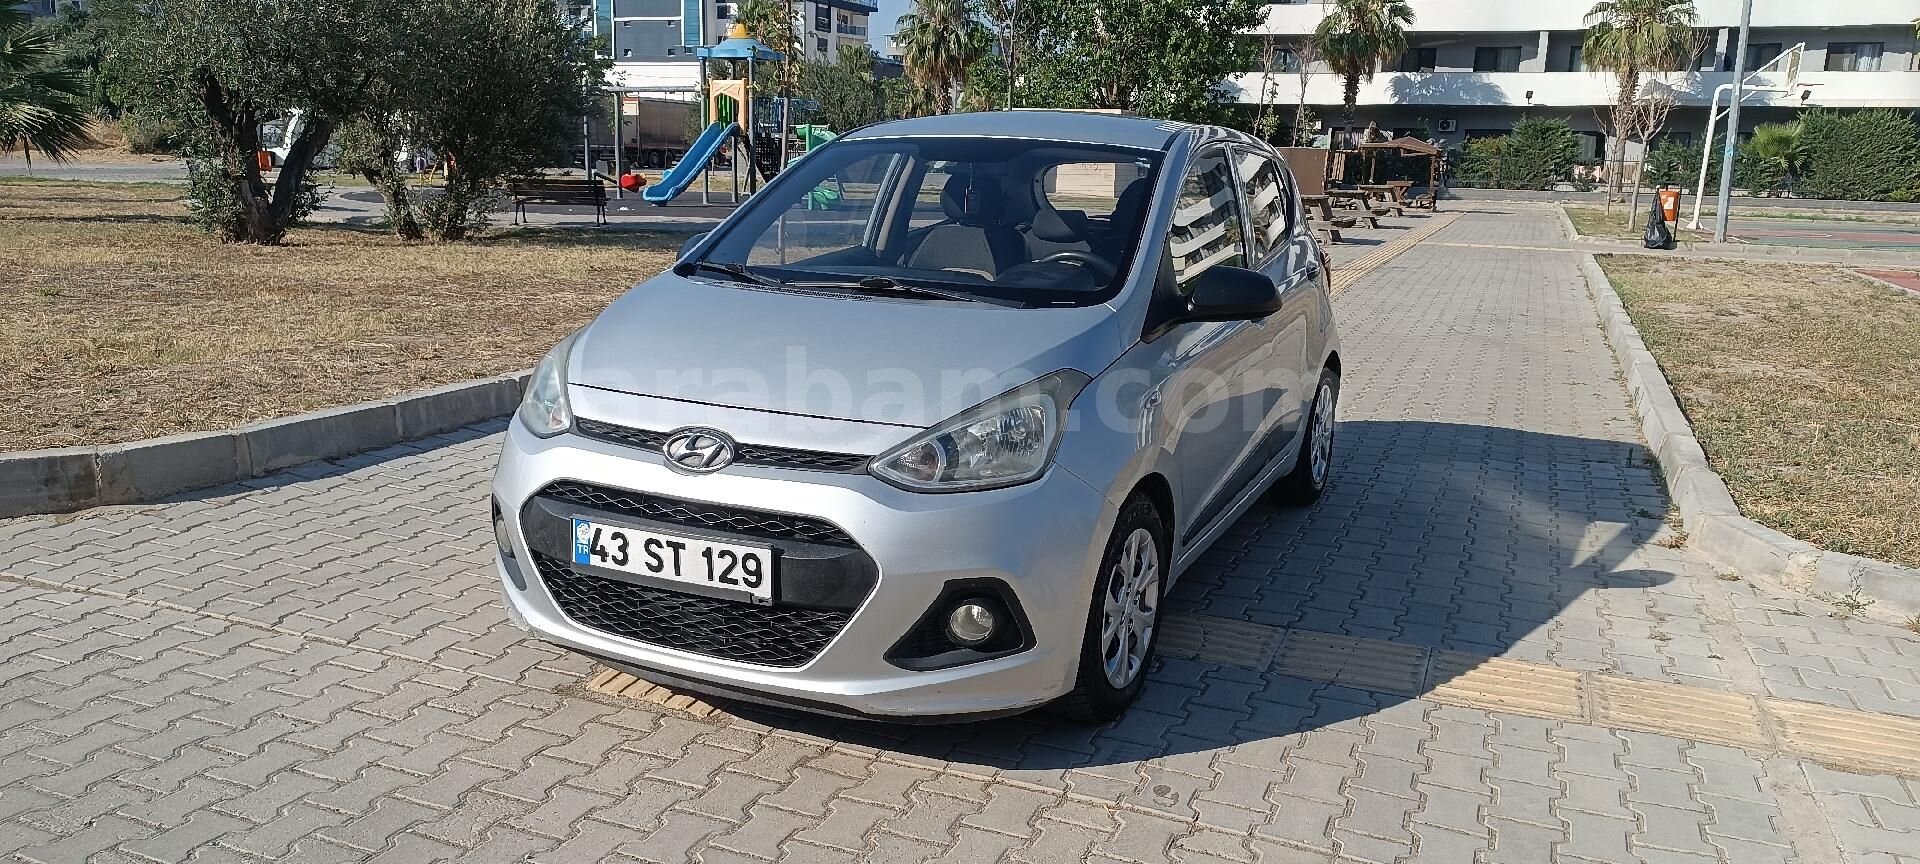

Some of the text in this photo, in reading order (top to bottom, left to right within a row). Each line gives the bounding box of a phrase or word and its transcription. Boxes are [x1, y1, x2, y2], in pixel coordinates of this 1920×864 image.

[577, 543, 590, 555] TR
[590, 527, 763, 589] 43 ST 129
